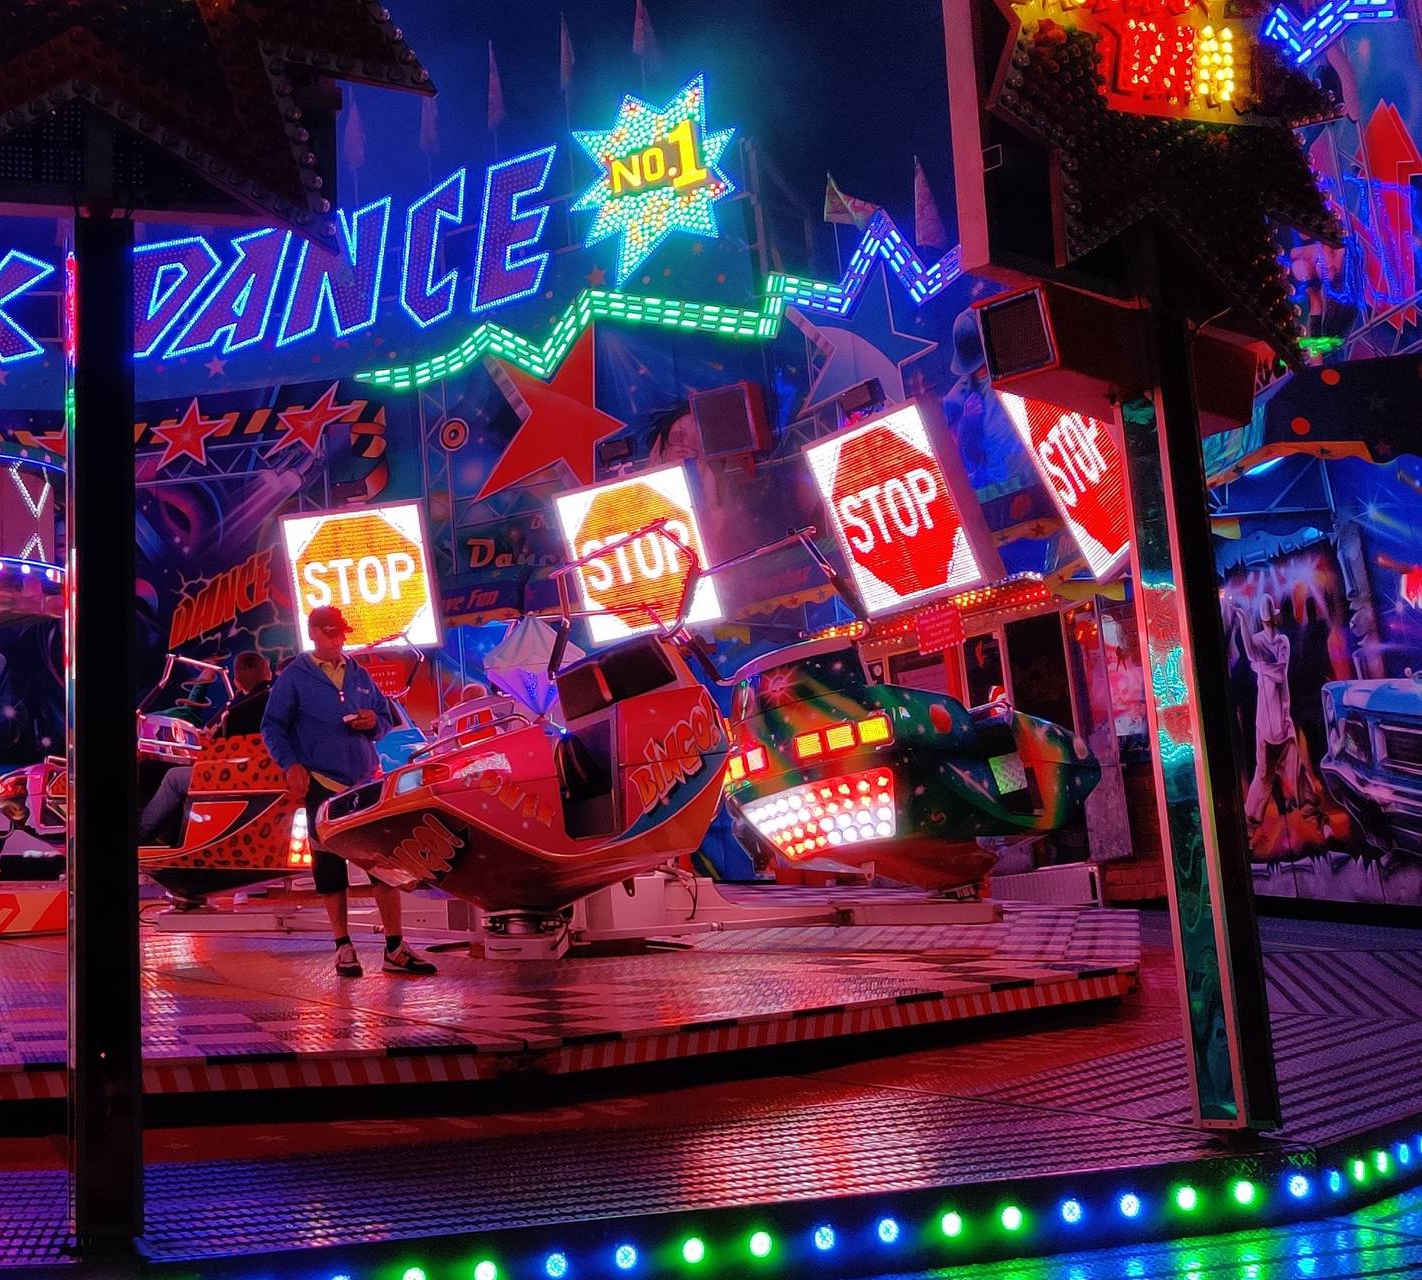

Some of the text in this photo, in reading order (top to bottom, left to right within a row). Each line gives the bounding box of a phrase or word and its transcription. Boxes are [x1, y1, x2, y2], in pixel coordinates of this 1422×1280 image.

[611, 119, 708, 193] NO.1
[134, 143, 558, 360] DANCE
[840, 468, 937, 554] STOP
[303, 552, 416, 608] STOP
[581, 519, 690, 590] STOP
[168, 547, 274, 650] DANCE
